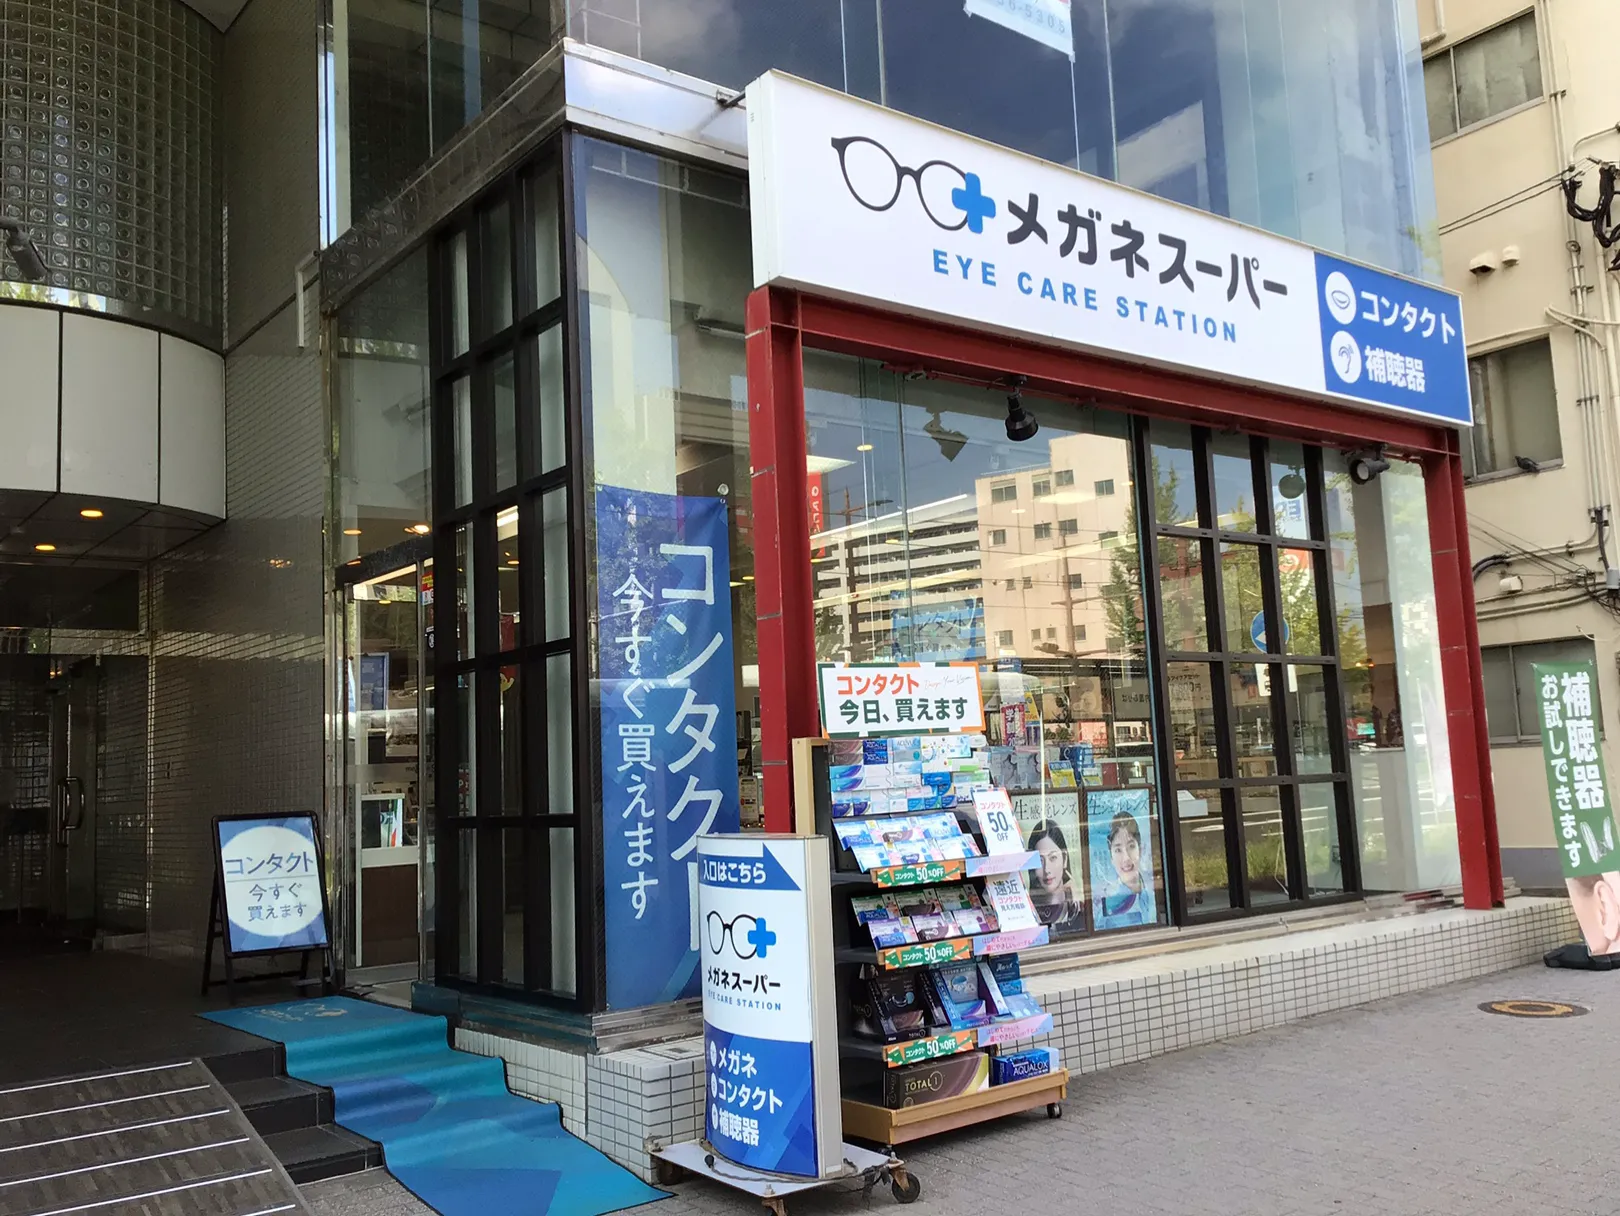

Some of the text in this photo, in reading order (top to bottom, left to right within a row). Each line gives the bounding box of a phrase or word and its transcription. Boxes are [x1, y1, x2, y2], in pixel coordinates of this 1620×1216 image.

[1007, 192, 1288, 310] メガネスーパー
[932, 248, 1237, 343] EYE CARE STATION
[1361, 289, 1456, 345] コンタクト
[1364, 344, 1426, 394] 補聴器
[837, 673, 919, 695] コンタクト
[839, 697, 968, 725] 今日、買えます
[613, 573, 658, 920] 今すぐ買えます
[1561, 671, 1605, 810] 補聴器
[1541, 673, 1582, 868] お試しできます
[980, 801, 1006, 810] コンタクト
[997, 832, 1009, 841] OFF
[225, 851, 313, 875] コンタクト
[703, 860, 766, 884] 入口はこちら
[894, 871, 915, 880] コンタクト
[249, 882, 302, 902] 今すぐ
[998, 895, 1022, 904] コンタクト
[248, 903, 307, 922] 買えます
[903, 951, 923, 960] コンタクト
[707, 967, 781, 995] メガネスーパー
[717, 993, 733, 1005] CARE
[737, 999, 782, 1011] STATION
[718, 1047, 758, 1078] メガネ
[906, 1047, 925, 1057] コンタクト
[1013, 1060, 1048, 1076] AQUALOX
[718, 1077, 783, 1113] コンタクト
[905, 1078, 932, 1092] TOTAL
[719, 1109, 759, 1147] 補聴器
